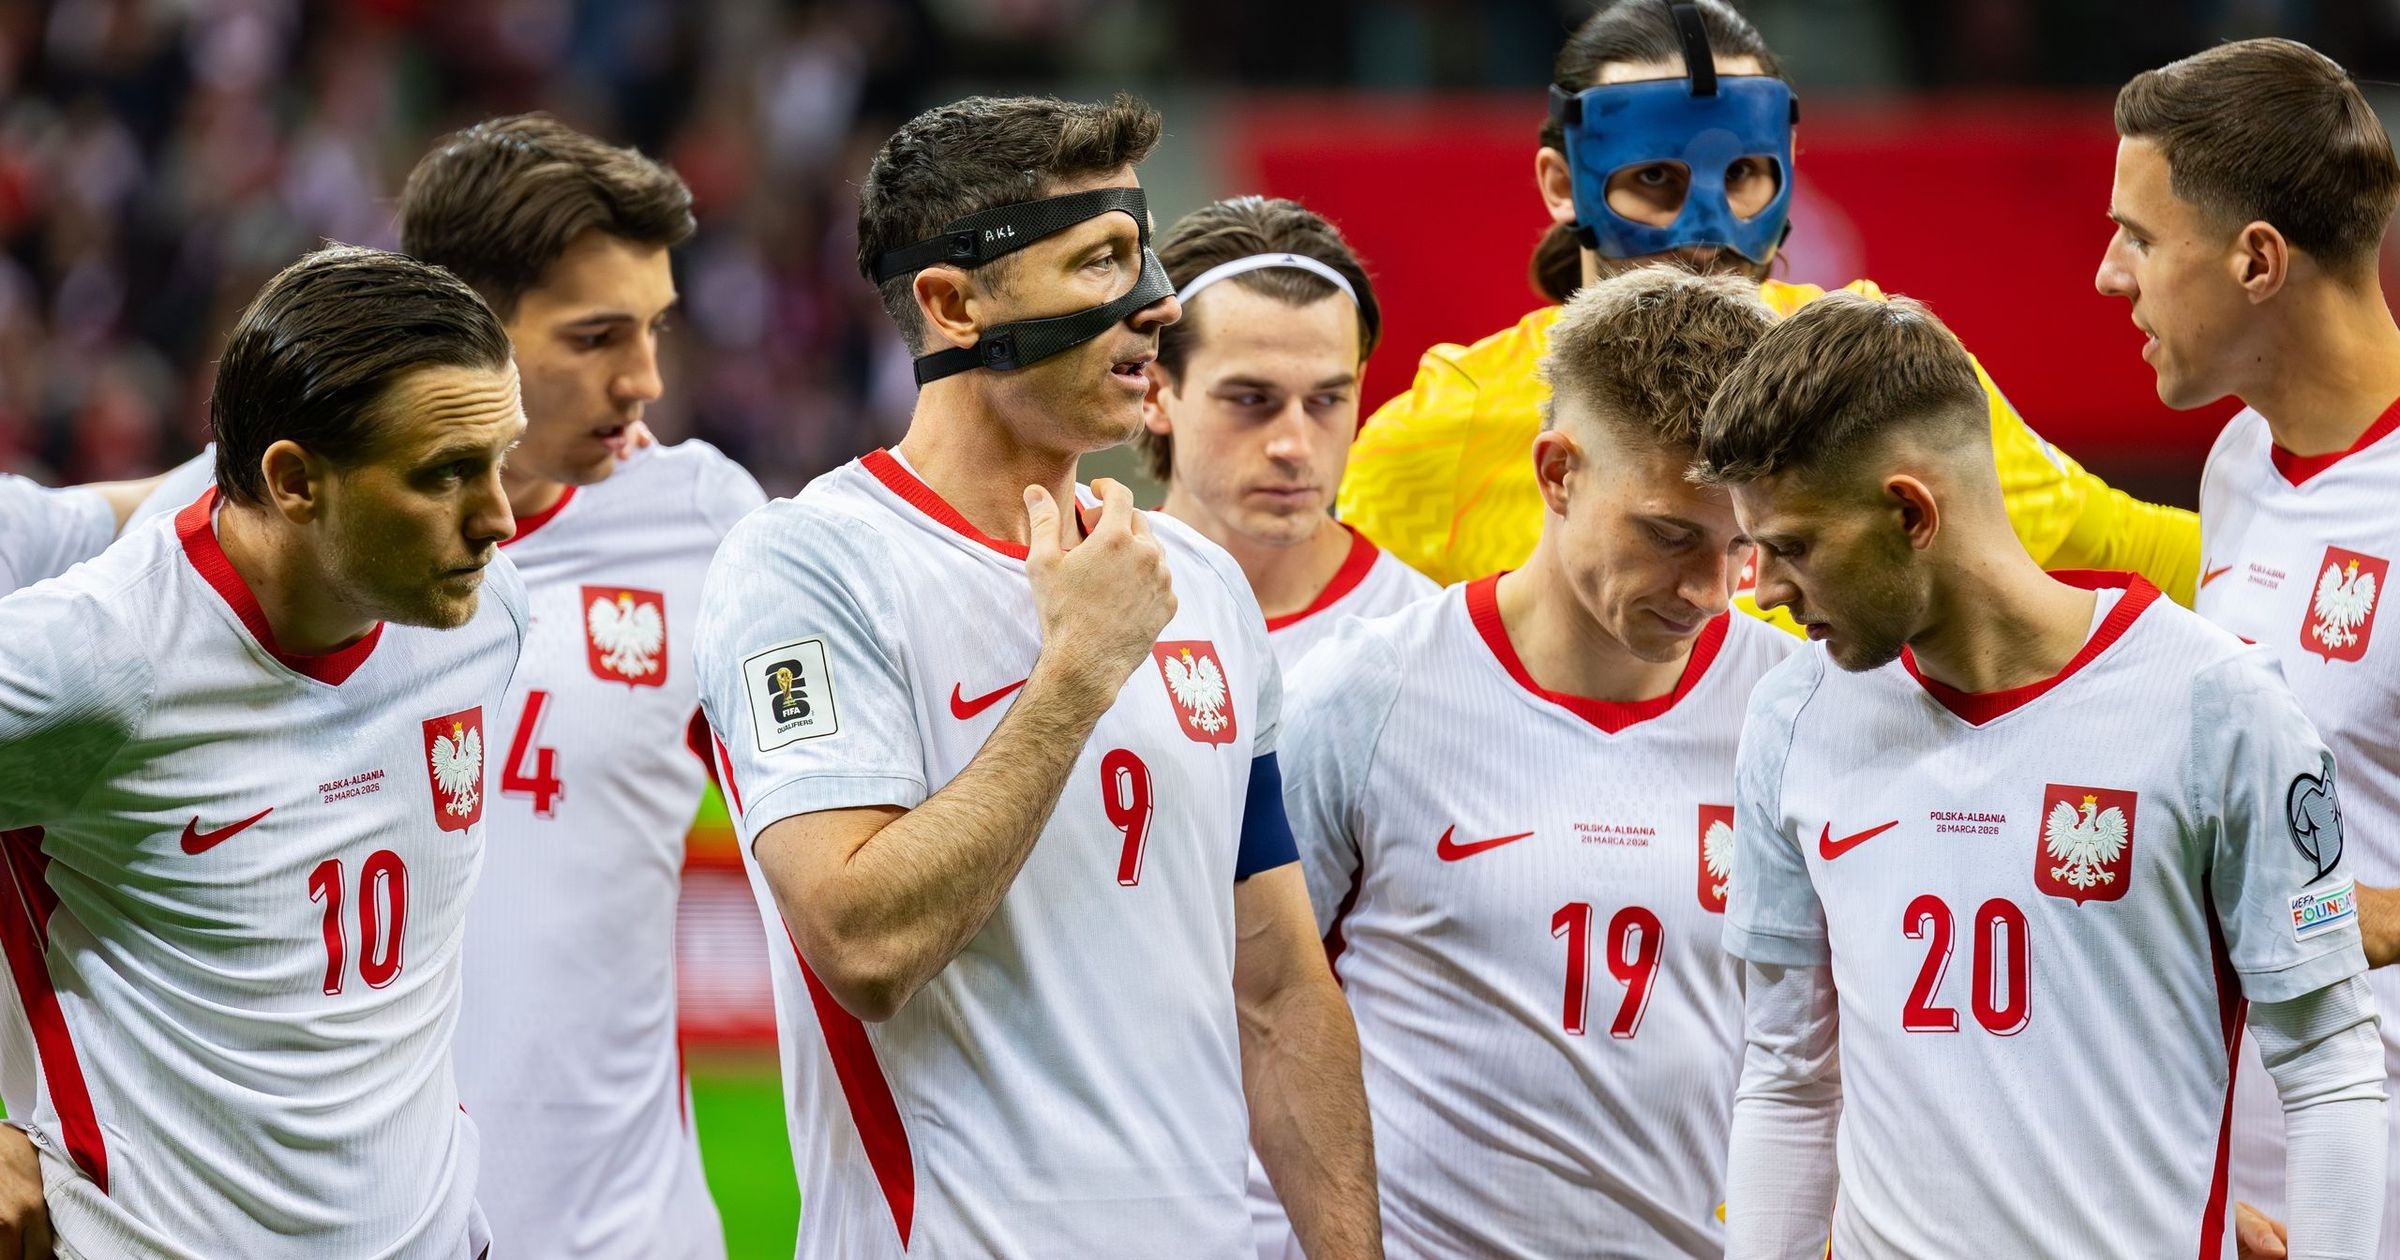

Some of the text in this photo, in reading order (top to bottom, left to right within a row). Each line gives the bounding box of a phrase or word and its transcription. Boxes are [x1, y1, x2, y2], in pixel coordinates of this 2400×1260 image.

[985, 224, 1015, 242] AKL
[782, 706, 801, 718] FIFA
[777, 718, 814, 734] QUALIFIERS
[500, 690, 564, 820] 4
[318, 769, 385, 794] POLSKA-ALBANIA
[324, 782, 380, 804] 26 MARCA 2026
[1100, 749, 1154, 886] 9
[1930, 811, 2006, 823] POLSKA-ALBANIA
[1574, 822, 1656, 836] POLSKA-ALBANIA
[1936, 824, 1999, 835] 26 MARCA 2026
[1593, 836, 1625, 846] MARCA
[2292, 895, 2315, 909] UEFA
[308, 849, 409, 996] 10
[1551, 902, 1665, 1039] 19
[1903, 894, 2032, 1036] 20
